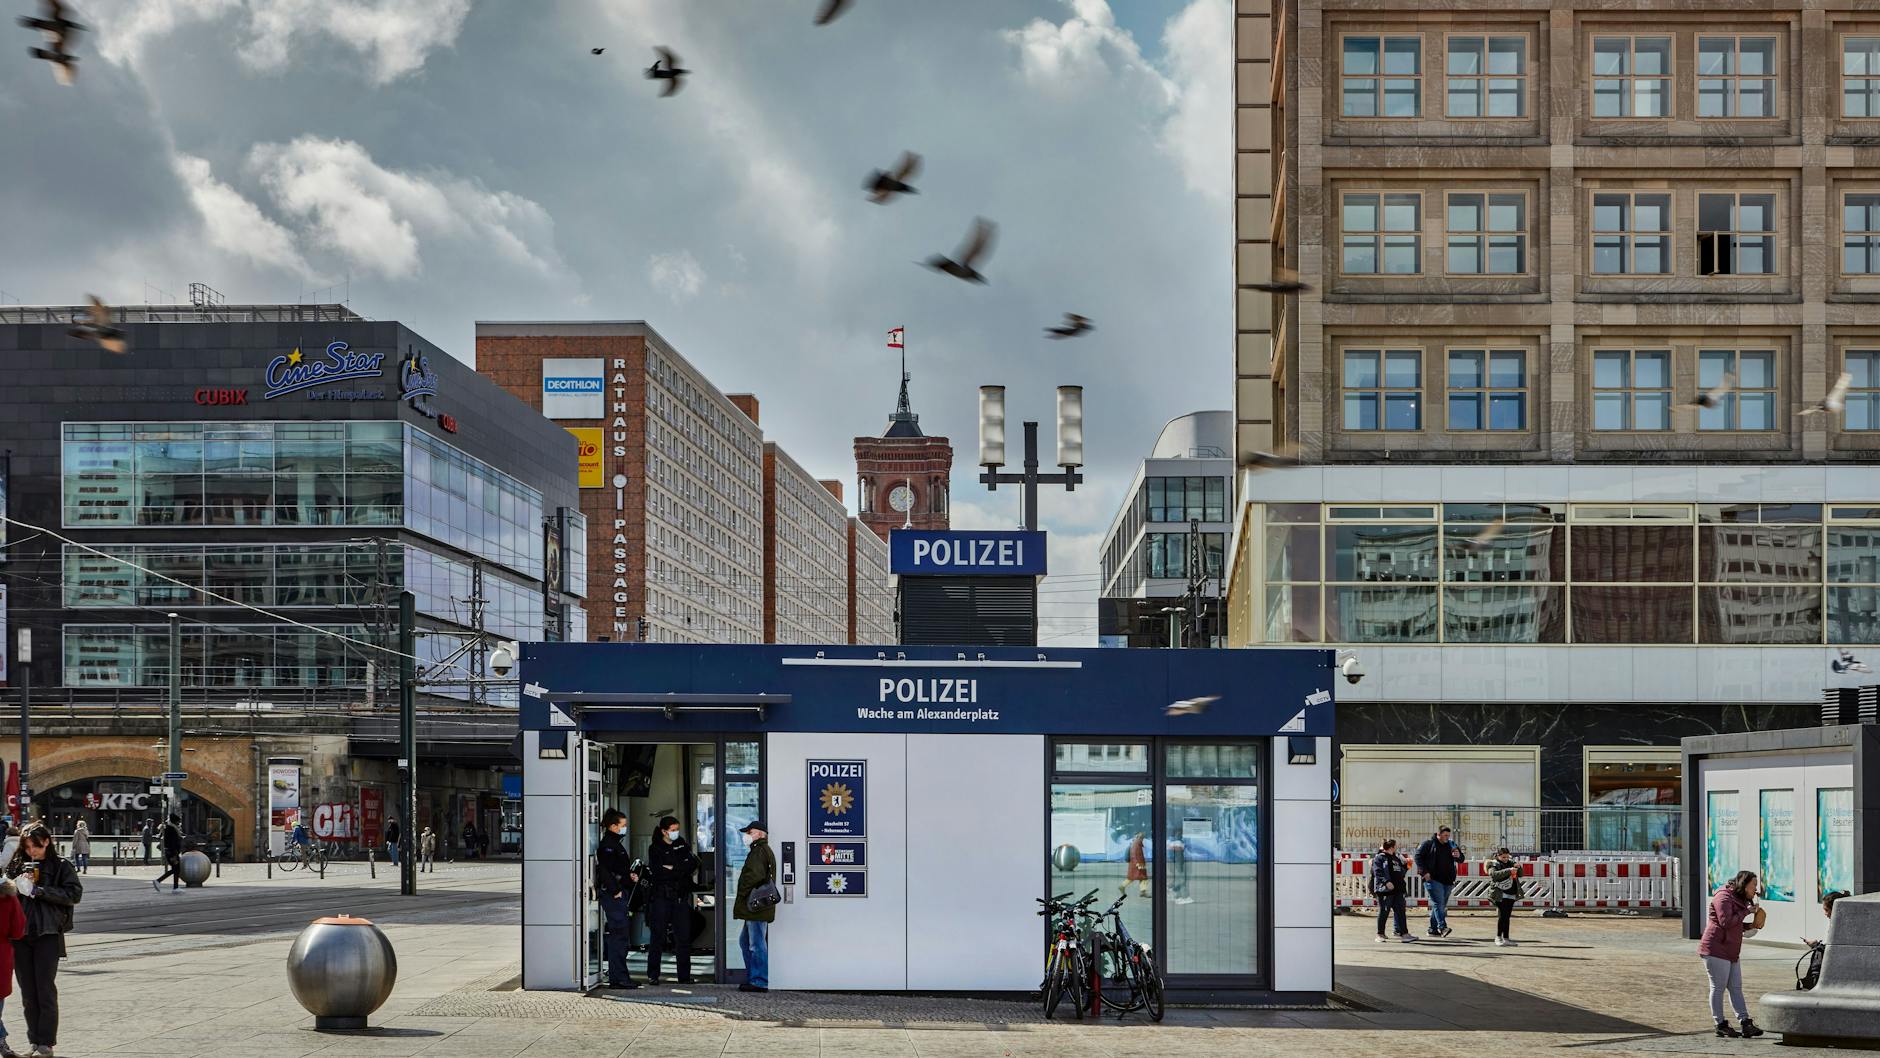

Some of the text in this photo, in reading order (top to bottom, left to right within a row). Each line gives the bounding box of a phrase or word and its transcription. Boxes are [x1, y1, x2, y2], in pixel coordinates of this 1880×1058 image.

[265, 341, 385, 389] CineStar
[548, 380, 600, 390] DECATHLON
[194, 388, 248, 405] CUBIX
[613, 358, 627, 633] RATHAUS PASSAGEN
[913, 539, 1024, 566] POLIZEI
[879, 679, 978, 703] POLIZEI
[857, 708, 999, 722] Wache am Alexanderplatz
[811, 764, 862, 778] POLIZEI
[101, 793, 150, 810] KFC
[1345, 827, 1410, 839] Wohlfühlen
[1461, 831, 1490, 843] Pflege
